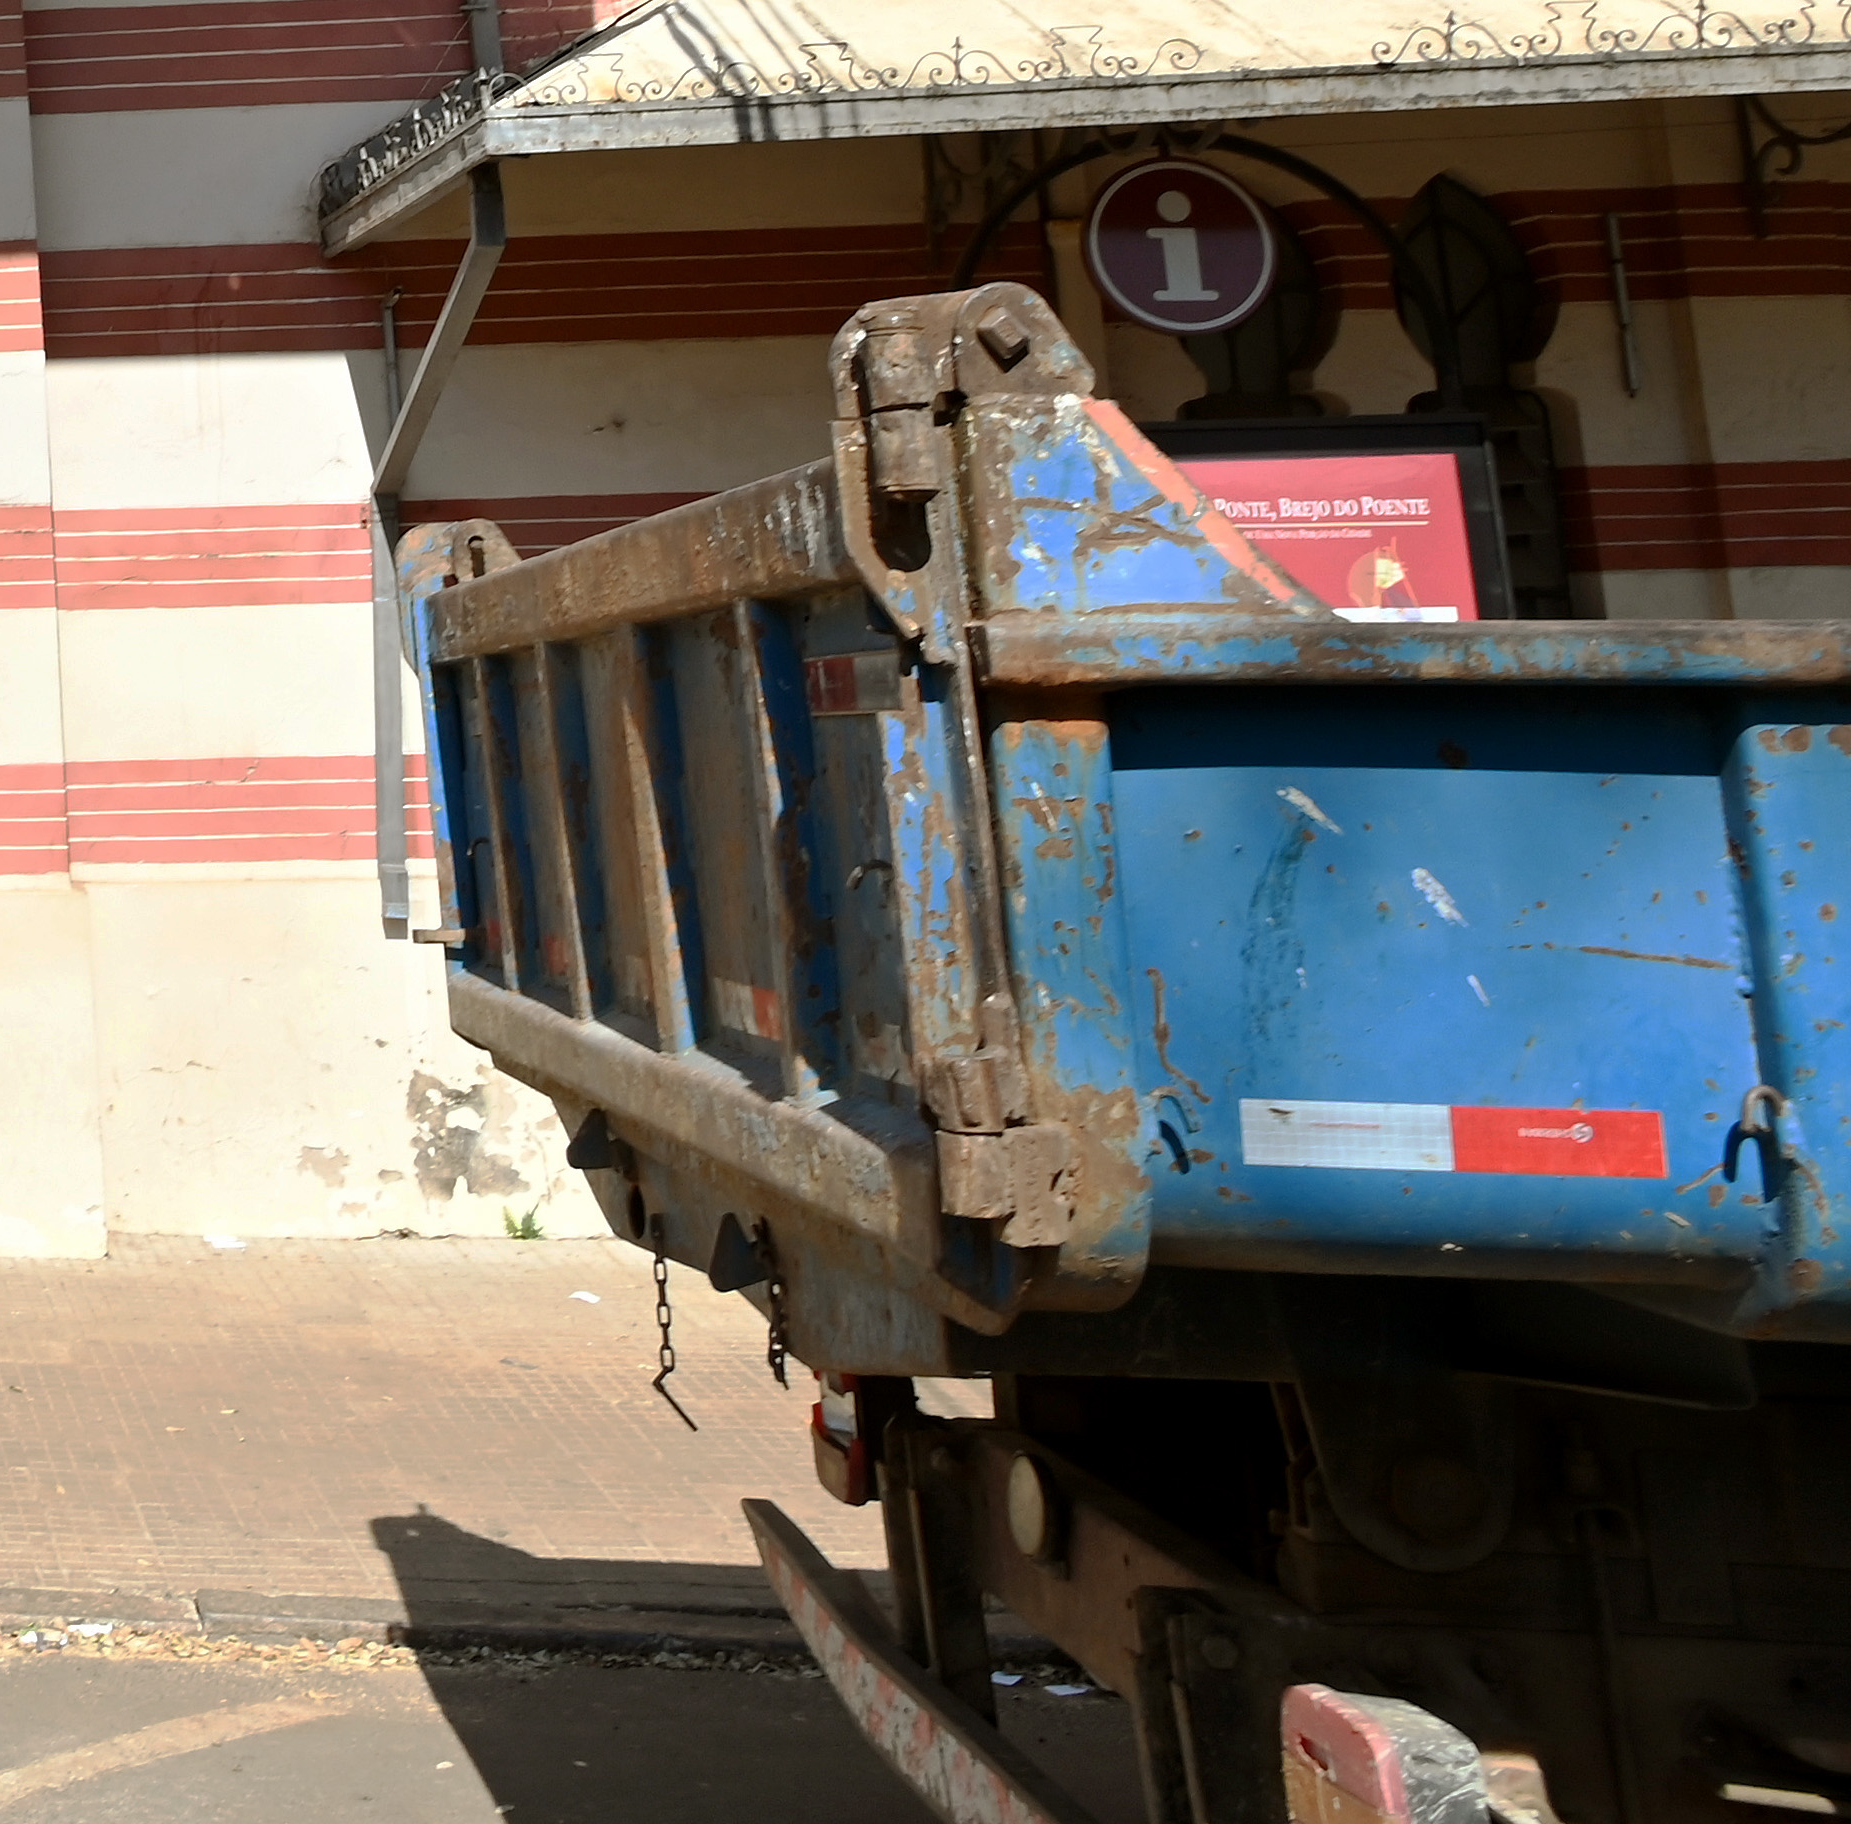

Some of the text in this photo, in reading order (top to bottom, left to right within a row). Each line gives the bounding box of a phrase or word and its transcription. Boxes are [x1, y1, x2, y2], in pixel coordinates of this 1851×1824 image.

[1278, 497, 1330, 521] BREJO
[1333, 499, 1358, 516] DO
[1360, 495, 1431, 517] POENTE
